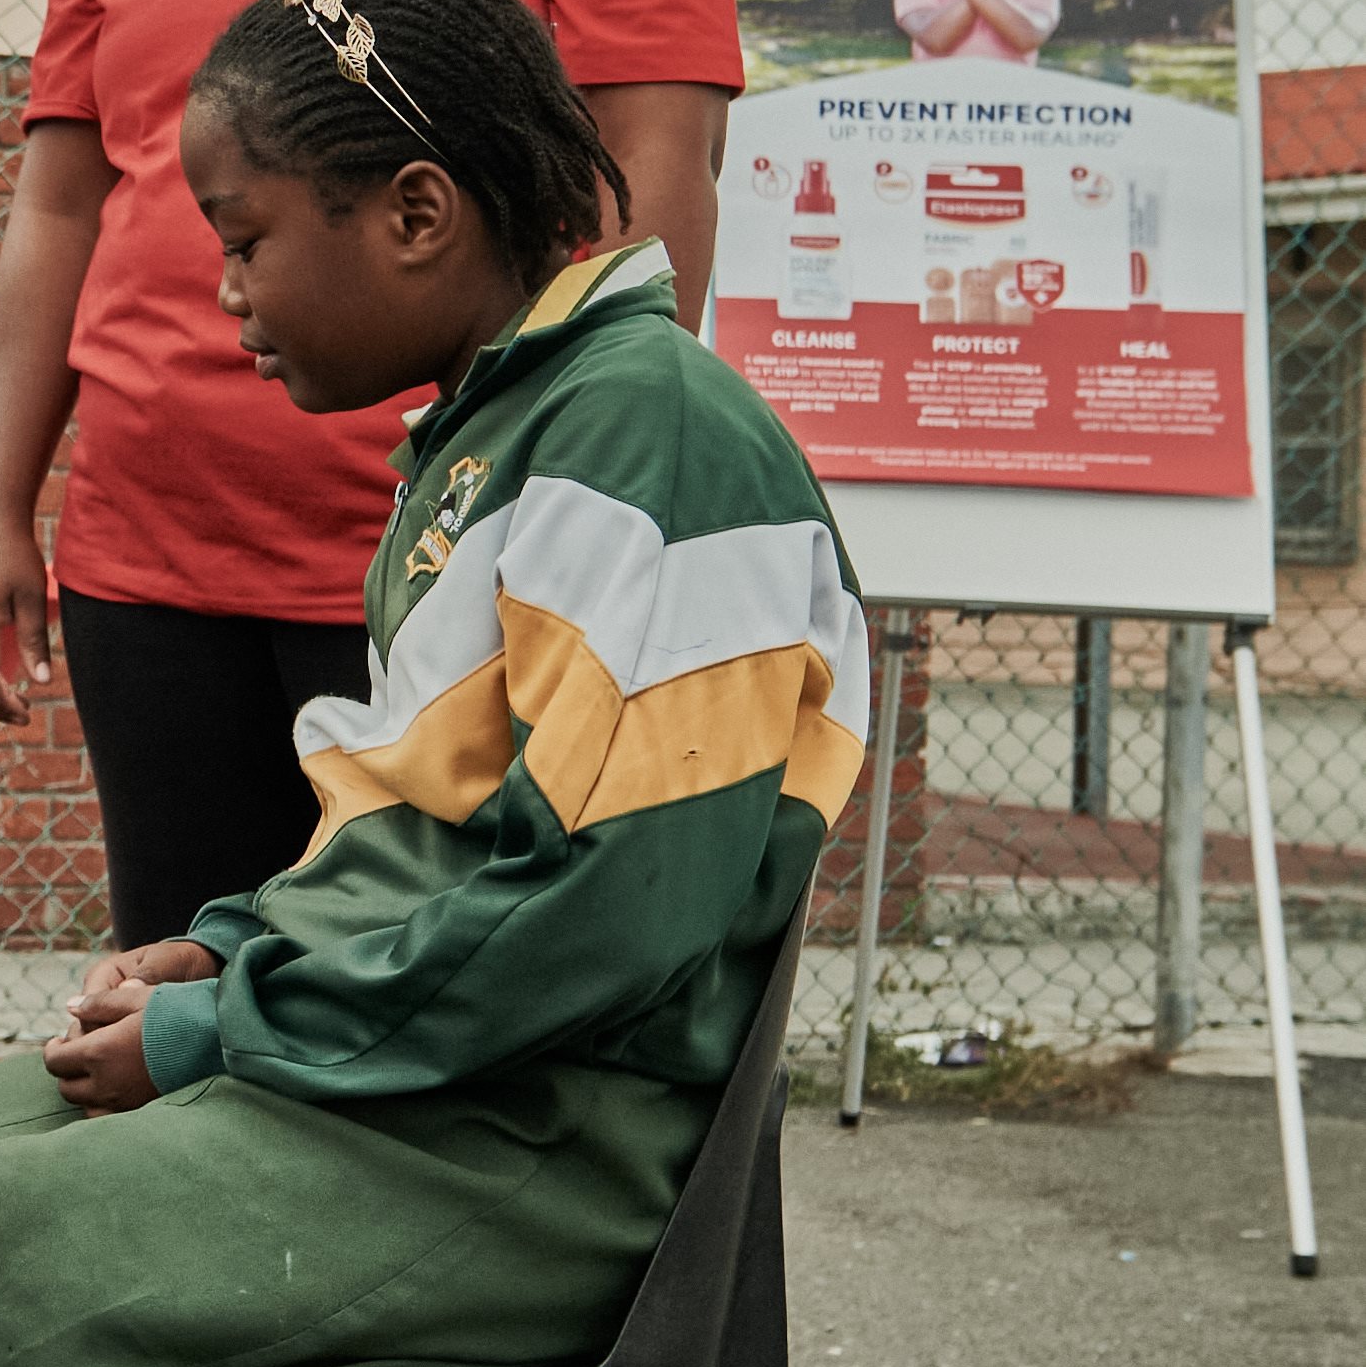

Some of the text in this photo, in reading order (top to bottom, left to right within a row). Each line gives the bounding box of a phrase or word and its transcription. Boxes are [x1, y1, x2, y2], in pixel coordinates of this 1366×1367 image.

[818, 99, 1132, 125] PREVENT INFECTION
[829, 125, 859, 141] UP
[867, 126, 894, 142] TO
[902, 127, 927, 144] 2X
[934, 129, 1016, 146] FASTER
[930, 199, 1020, 218] Elastoplast
[771, 329, 857, 350] CLEANSE
[932, 334, 1021, 355] PROTECT
[1119, 340, 1171, 359] HEAL
